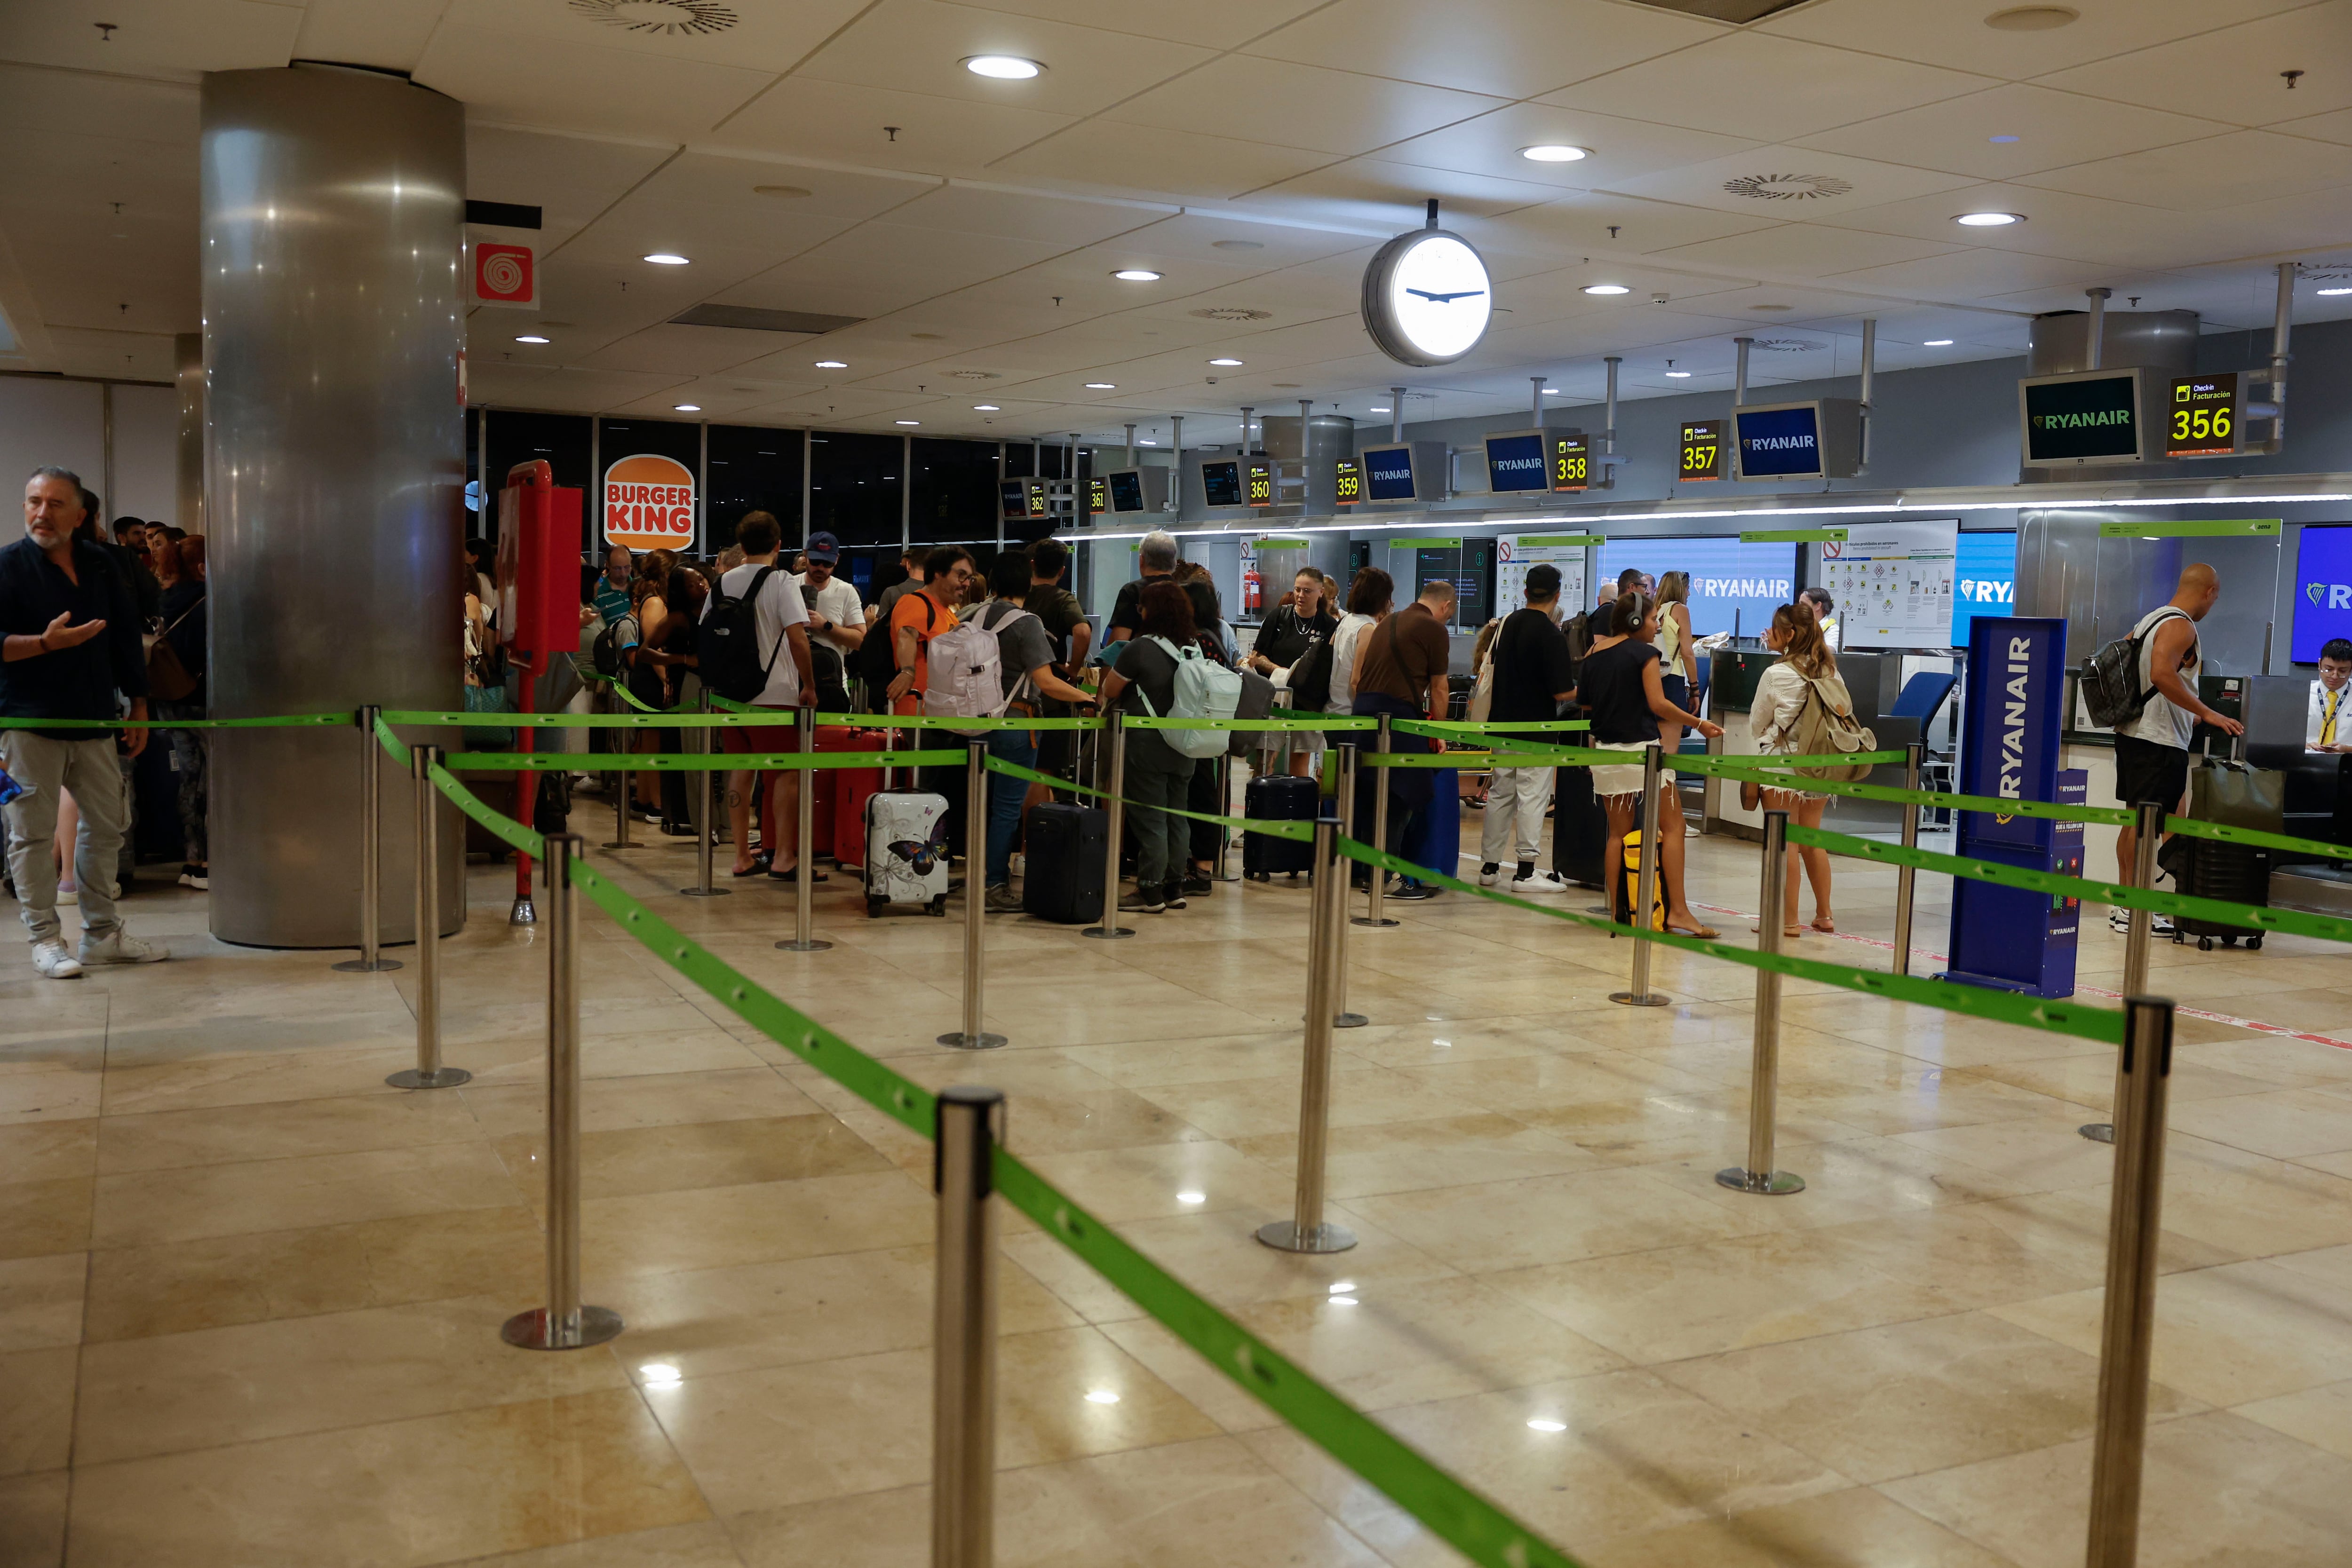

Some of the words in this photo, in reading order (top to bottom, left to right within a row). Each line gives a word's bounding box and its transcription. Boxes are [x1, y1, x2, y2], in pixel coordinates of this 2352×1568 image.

[2193, 391, 2230, 400] Facturación
[2046, 410, 2130, 429] RYANAIR
[2172, 407, 2231, 440] 356
[1752, 436, 1814, 451] RYANAIR
[1498, 458, 1542, 471] RYANAIR
[1683, 446, 1716, 470] 357
[1374, 469, 1410, 481] RYANAIR
[1557, 458, 1586, 480] 358
[607, 484, 691, 506] BURGER
[1251, 481, 1269, 498] 360
[1337, 477, 1358, 496] 359
[1032, 497, 1043, 511] 362
[1091, 492, 1104, 507] 361
[607, 504, 691, 533] KING
[1705, 578, 1789, 598] RYANAIR
[2000, 637, 2031, 799] RYANAIR
[2053, 927, 2075, 935] RYANAIR
